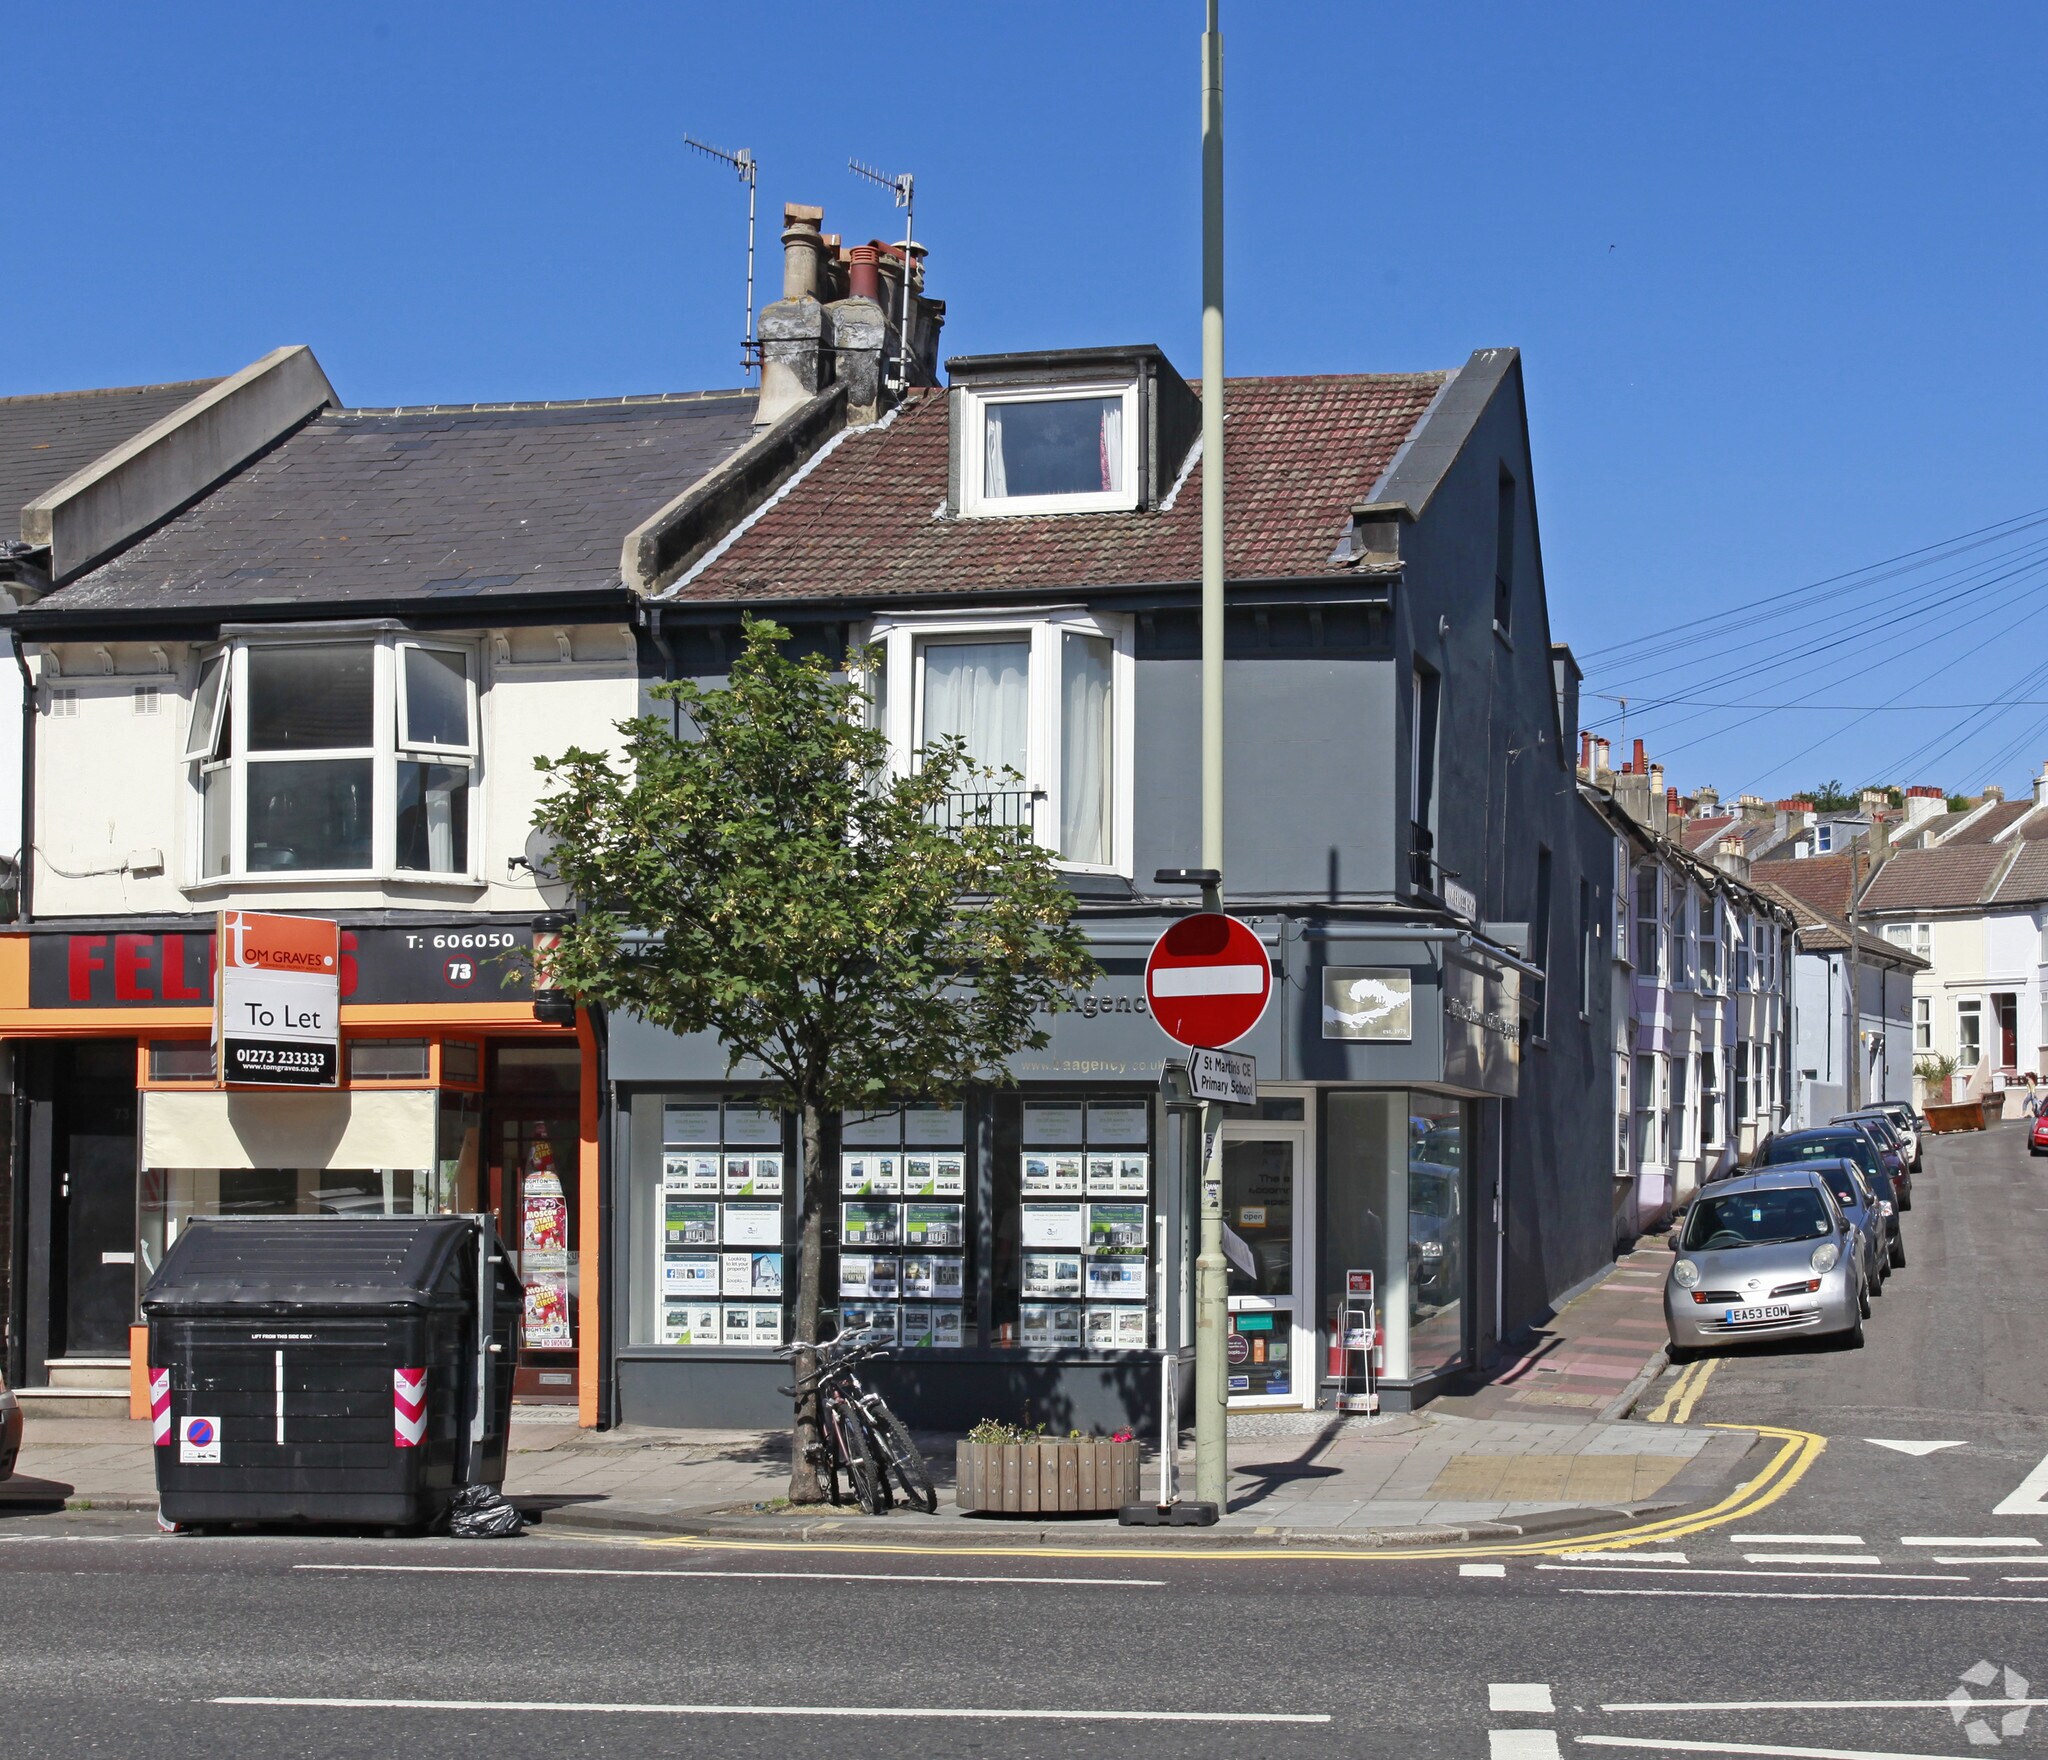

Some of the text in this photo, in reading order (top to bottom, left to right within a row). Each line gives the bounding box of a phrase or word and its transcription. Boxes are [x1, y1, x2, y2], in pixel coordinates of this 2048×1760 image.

[406, 933, 515, 949] T: 606050
[273, 951, 322, 966] GRAVES
[449, 963, 472, 980] 73
[1066, 993, 1152, 1019] Agenc
[244, 1002, 321, 1029] To Let
[236, 1049, 325, 1066] 01273 233333
[242, 1063, 320, 1073] www.tomgraves.co.uk
[1204, 1056, 1251, 1077] St Martin's CE
[1202, 1075, 1253, 1096] Primary School
[526, 1209, 557, 1219] MOSCOW
[534, 1216, 554, 1225] STATE
[533, 1221, 557, 1234] CIRCUS
[526, 1285, 557, 1295] MOSCOW
[536, 1291, 554, 1300] STATE
[536, 1296, 557, 1308] CIRCUS
[1734, 1306, 1787, 1320] EA53 EOM
